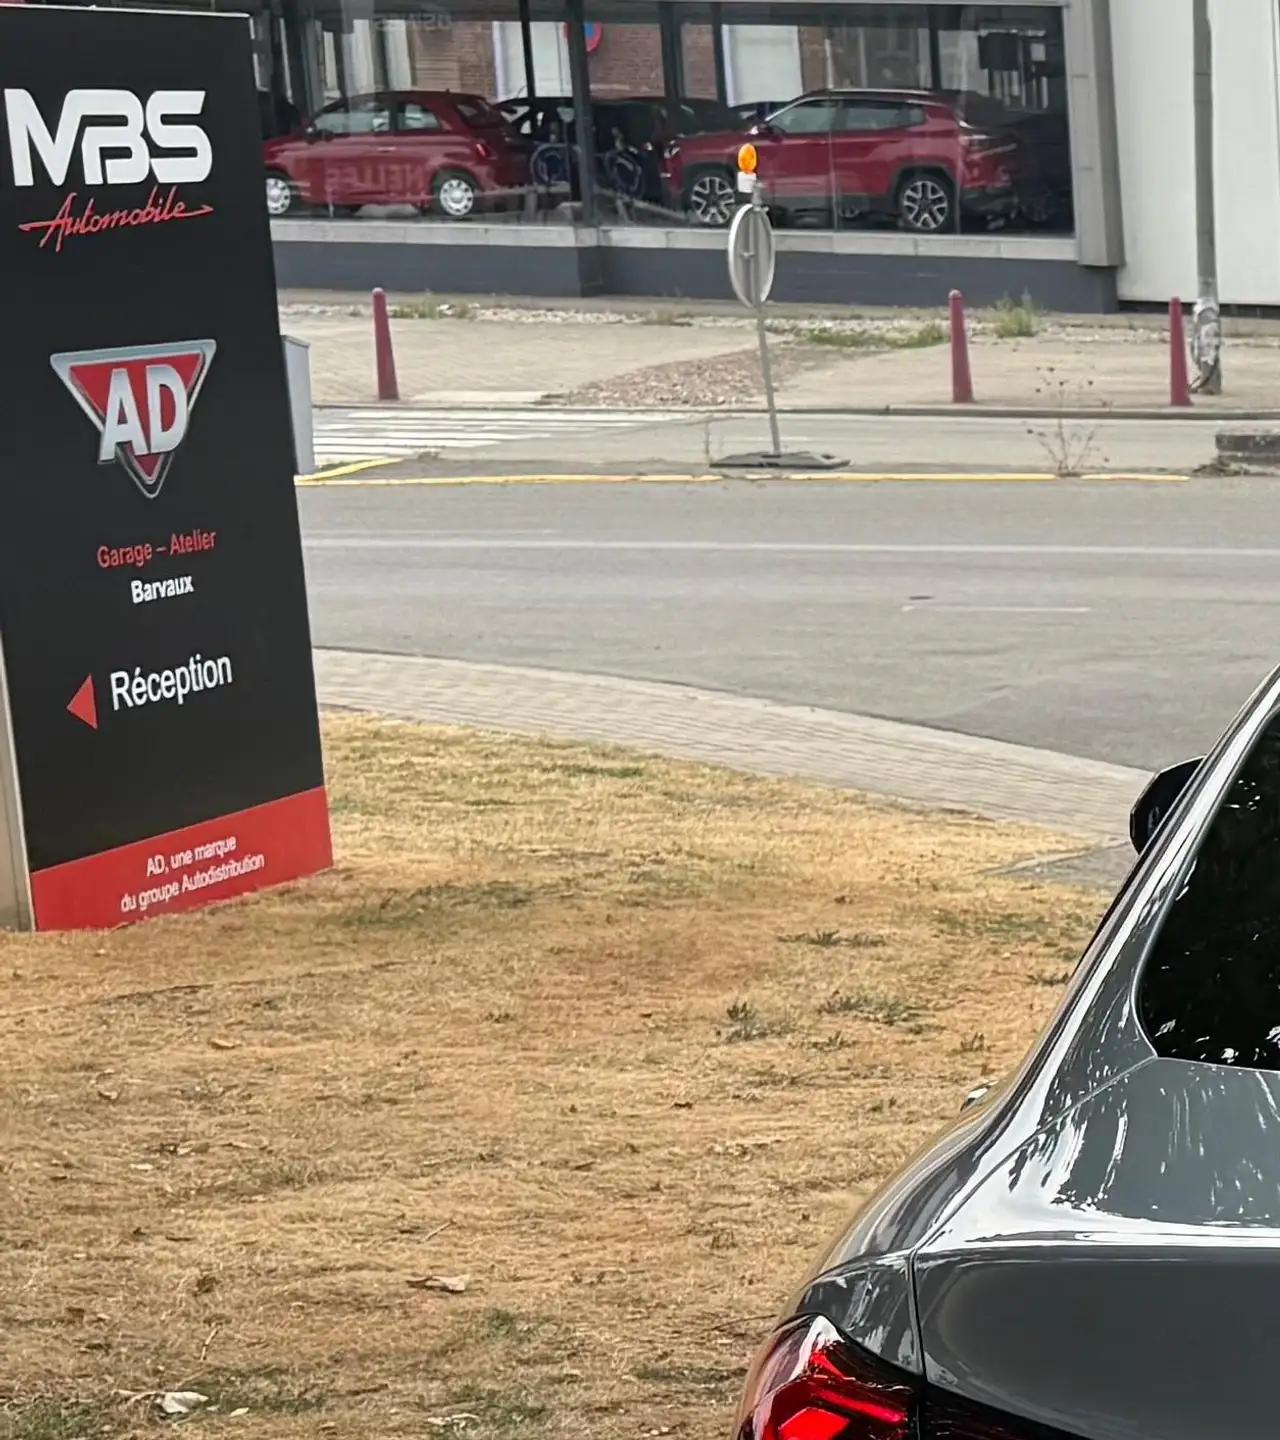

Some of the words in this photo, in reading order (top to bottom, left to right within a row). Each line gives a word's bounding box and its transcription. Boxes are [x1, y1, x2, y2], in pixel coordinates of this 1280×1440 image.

[4, 88, 213, 187] MBS
[18, 185, 214, 252] Automobile
[99, 363, 188, 463] AD
[97, 543, 153, 569] Garage
[170, 528, 217, 556] Atelier
[131, 575, 194, 604] Barvaux
[110, 653, 233, 711] Réception
[120, 892, 137, 913] du
[138, 880, 180, 912] groupe
[181, 852, 265, 894] Autodistribution
[146, 854, 169, 877] AD,
[170, 848, 193, 870] une
[194, 835, 237, 862] marque
